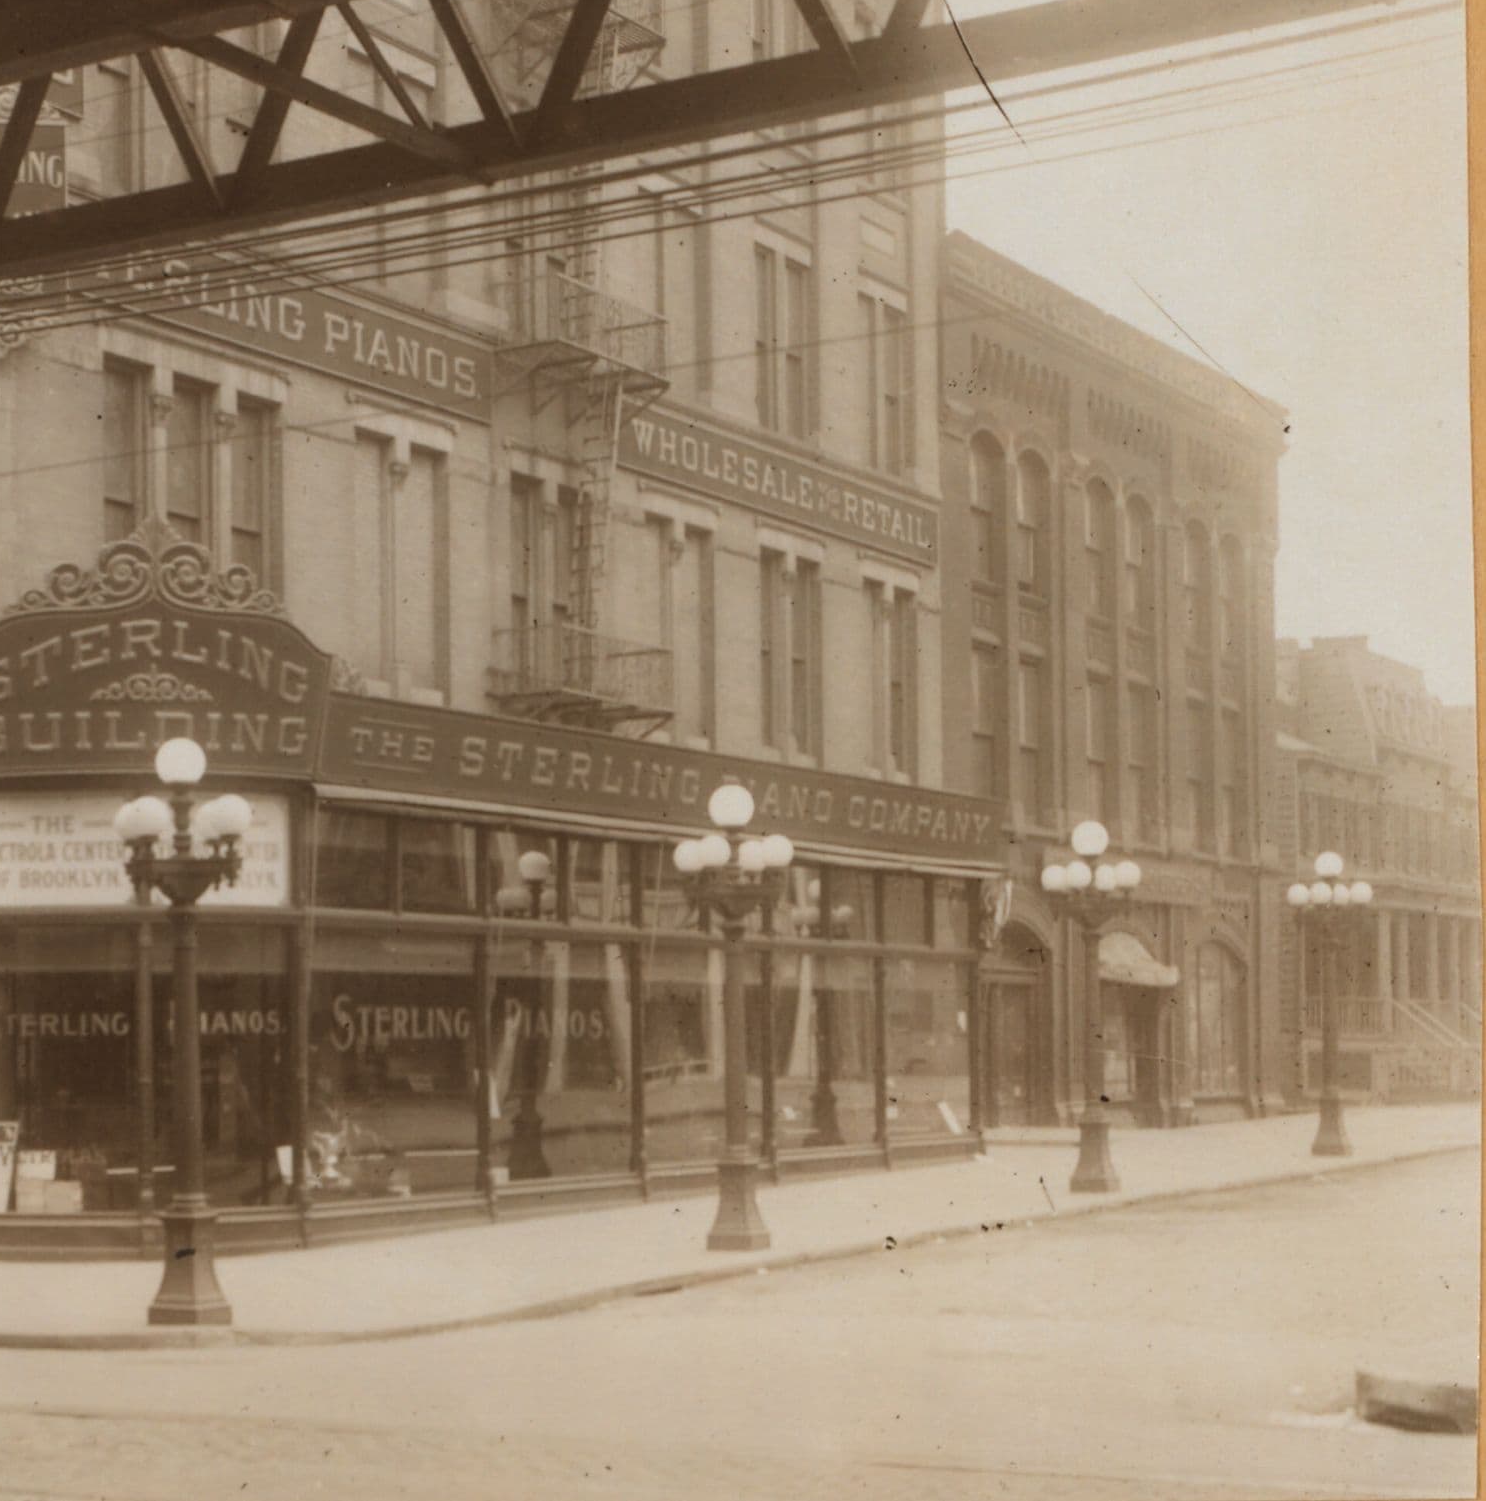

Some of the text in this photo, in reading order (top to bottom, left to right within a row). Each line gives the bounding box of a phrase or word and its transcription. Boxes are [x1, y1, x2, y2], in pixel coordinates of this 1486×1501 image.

[632, 419, 814, 509] WHOLESALE
[843, 491, 930, 548] RETAIL
[350, 728, 435, 761] THE
[458, 736, 701, 804] STERLING
[721, 775, 833, 823] ANO
[32, 815, 74, 834] THE
[168, 1000, 286, 1045] IANOS.
[330, 994, 470, 1052] STERLING
